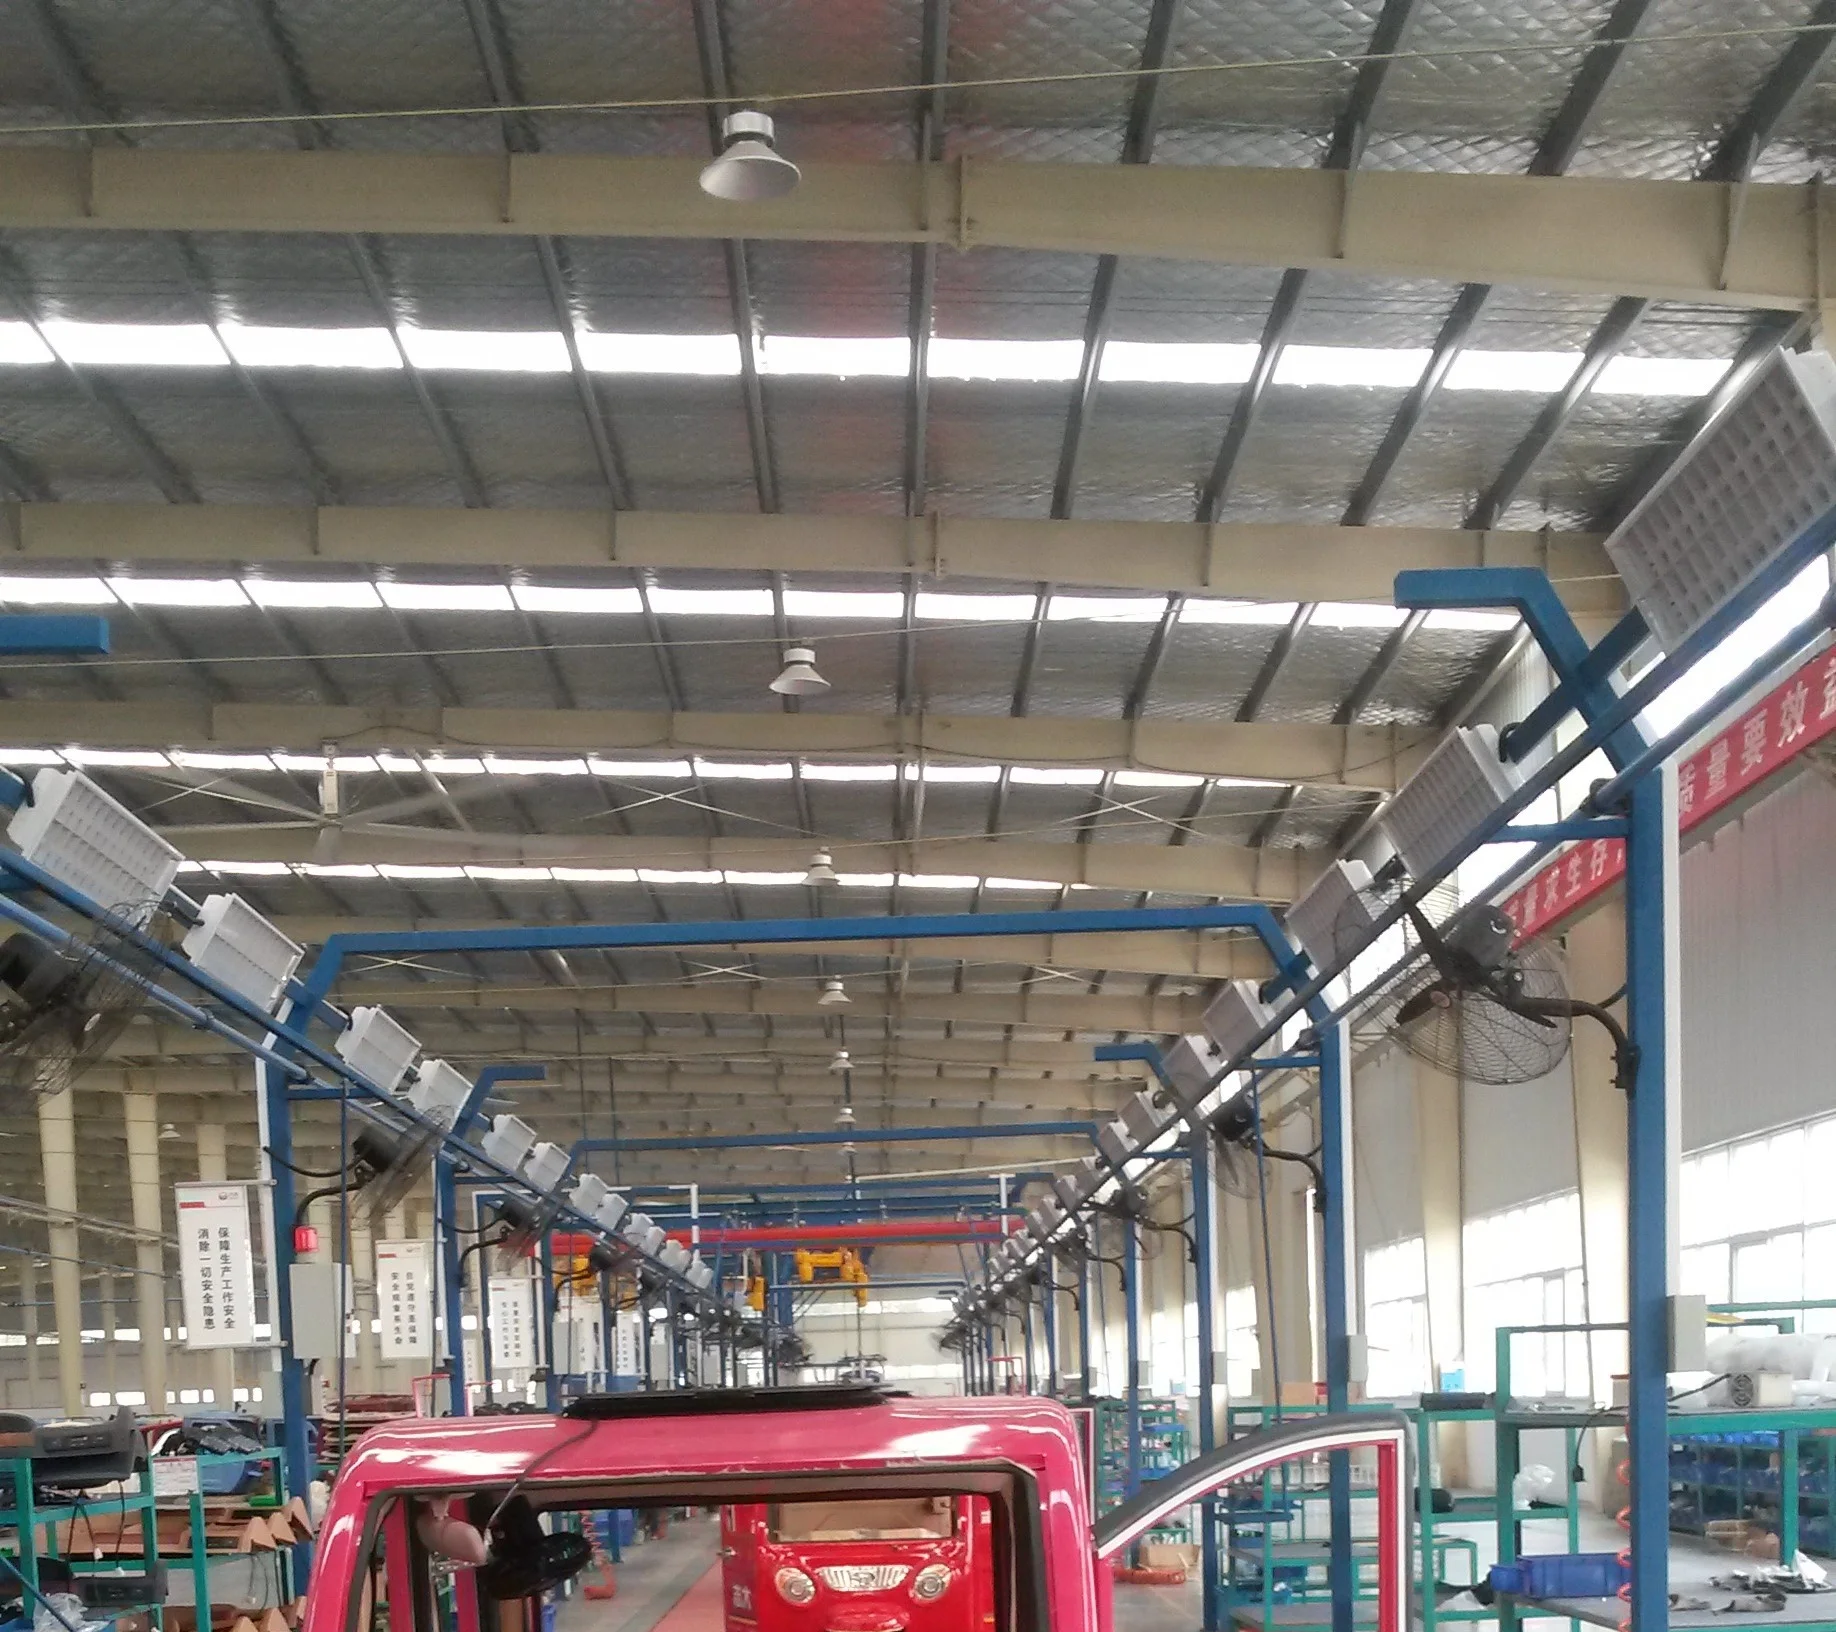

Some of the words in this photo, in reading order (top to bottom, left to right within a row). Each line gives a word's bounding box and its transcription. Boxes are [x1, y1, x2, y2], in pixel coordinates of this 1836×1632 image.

[197, 1228, 216, 1330] 消除一切安全隐患
[218, 1227, 236, 1329] 保障生产工作安全
